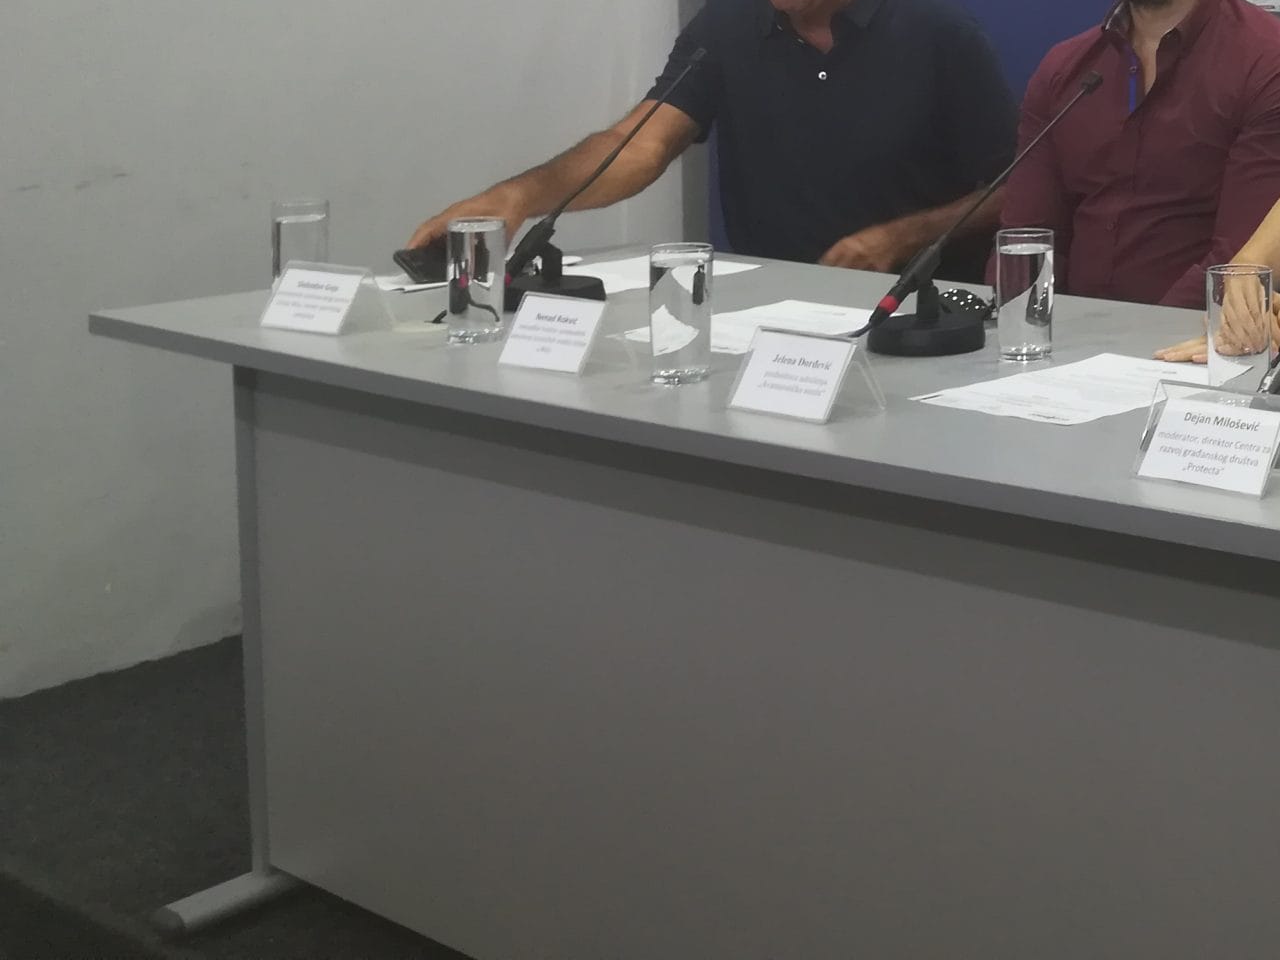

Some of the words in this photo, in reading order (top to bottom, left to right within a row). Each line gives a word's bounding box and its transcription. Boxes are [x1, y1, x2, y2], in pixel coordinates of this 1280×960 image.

[1184, 411, 1210, 425] Dejan
[1213, 415, 1260, 432] Milošević
[1201, 435, 1232, 447] direktor
[1234, 440, 1260, 452] Centra
